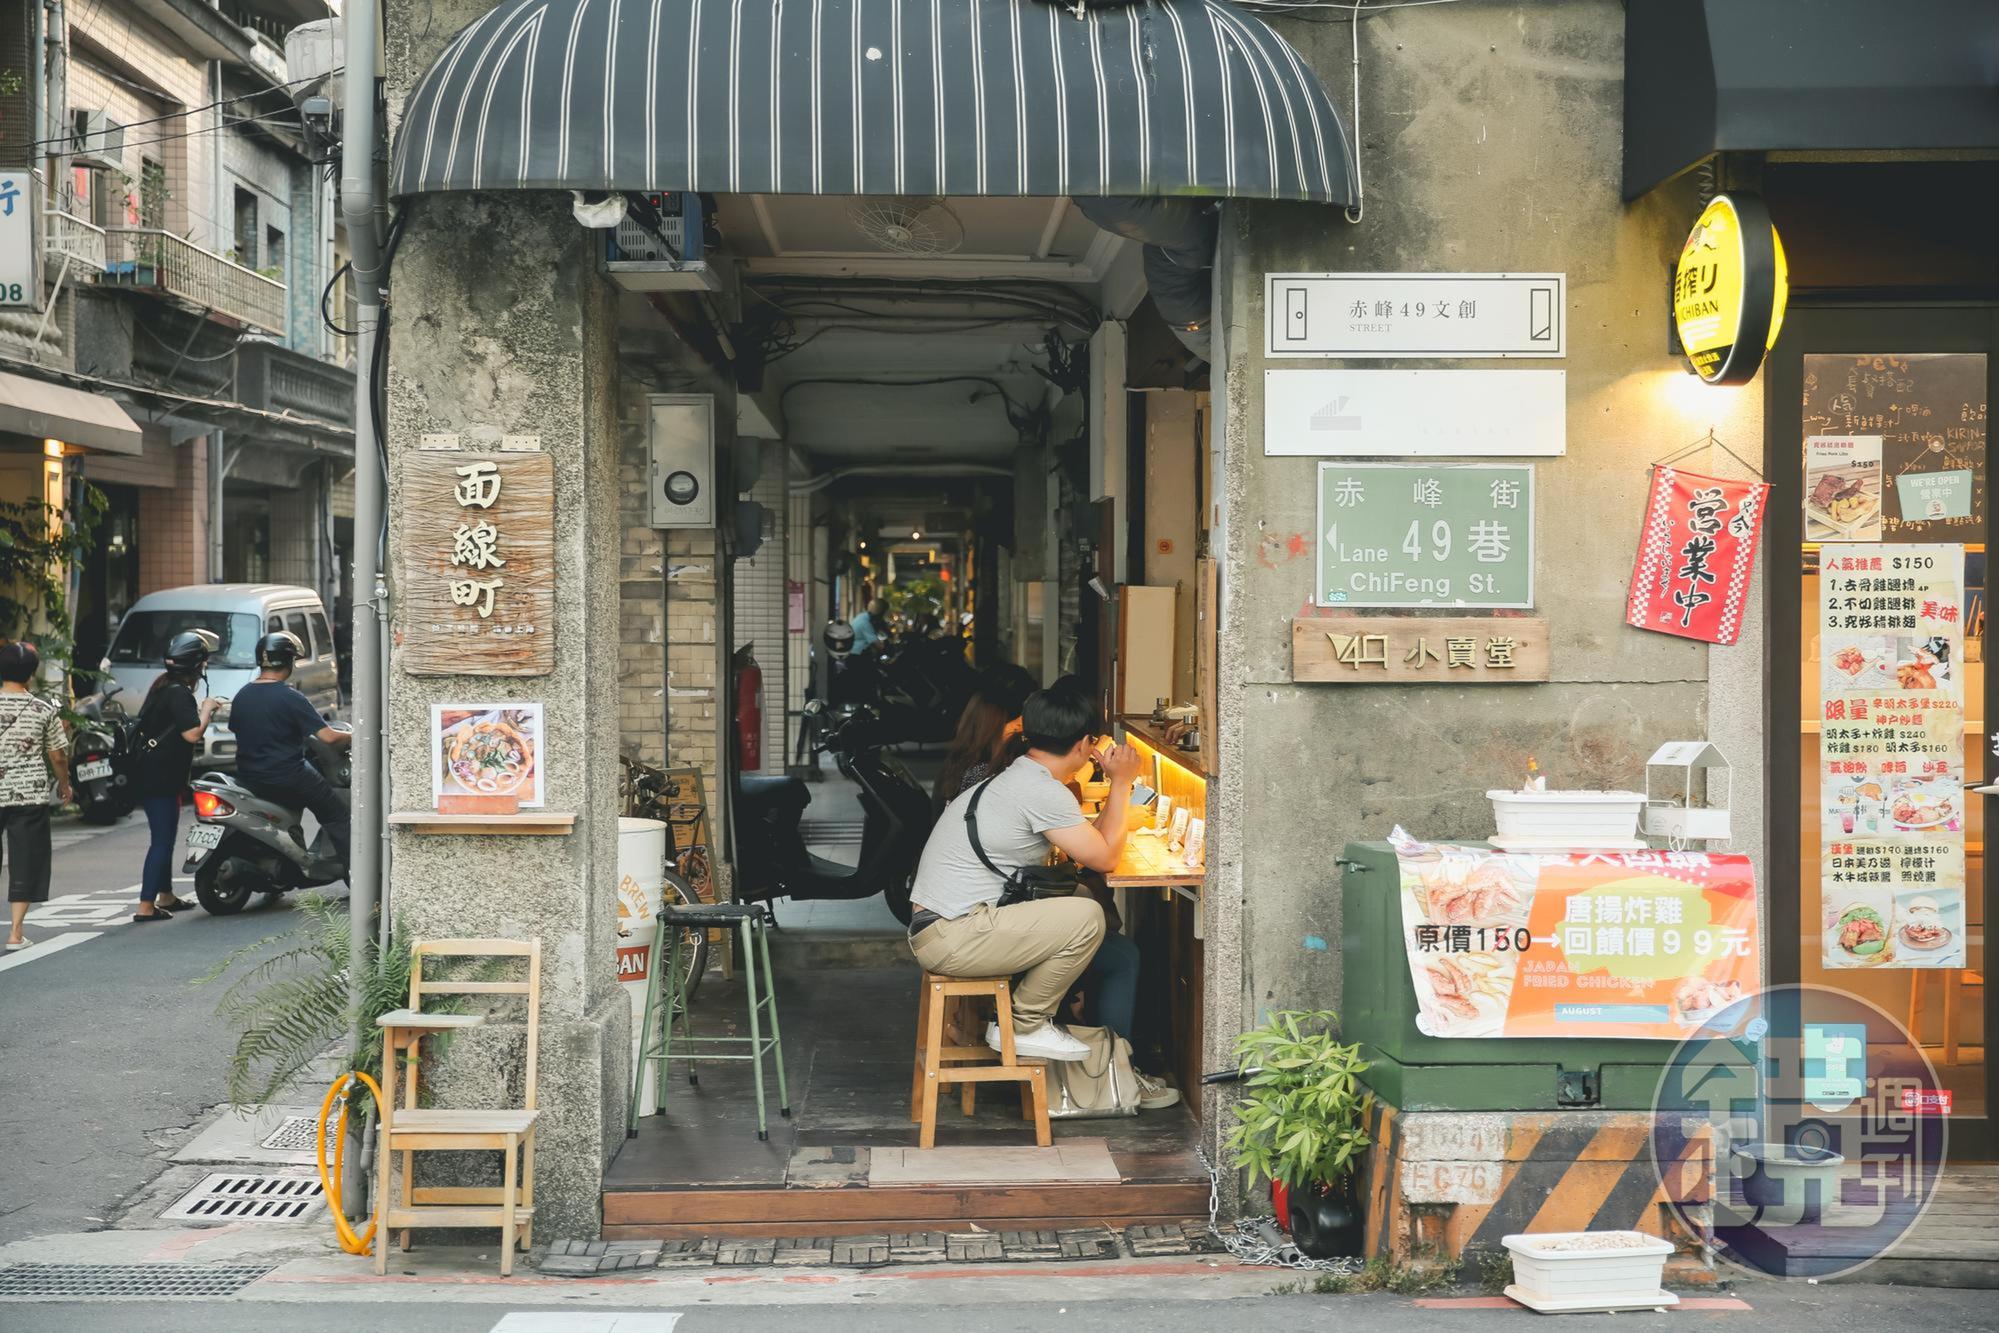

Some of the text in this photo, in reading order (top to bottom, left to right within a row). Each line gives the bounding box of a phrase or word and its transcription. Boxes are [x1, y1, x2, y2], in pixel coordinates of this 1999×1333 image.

[1349, 299, 1477, 319] 赤峰49文創
[1349, 323, 1392, 333] STREET
[1910, 475, 1960, 488] WE'RE OPEN
[1334, 477, 1521, 509] 赤峰街
[449, 461, 506, 618] 面線町
[1339, 544, 1389, 563] Lane
[1893, 557, 1934, 569] $150
[1350, 572, 1451, 597] ChiFeng
[1468, 573, 1501, 594] St.
[1920, 600, 1959, 623] 美味
[1403, 637, 1518, 670] 小賣堂
[1825, 699, 1869, 721] 限量
[1900, 731, 1926, 739] $240
[1564, 895, 1683, 925] 唐揚炸雞
[1523, 960, 1580, 973] JAPAN
[1523, 975, 1655, 989] FRIED CHICKEN
[1561, 1007, 1602, 1016] AUGUST
